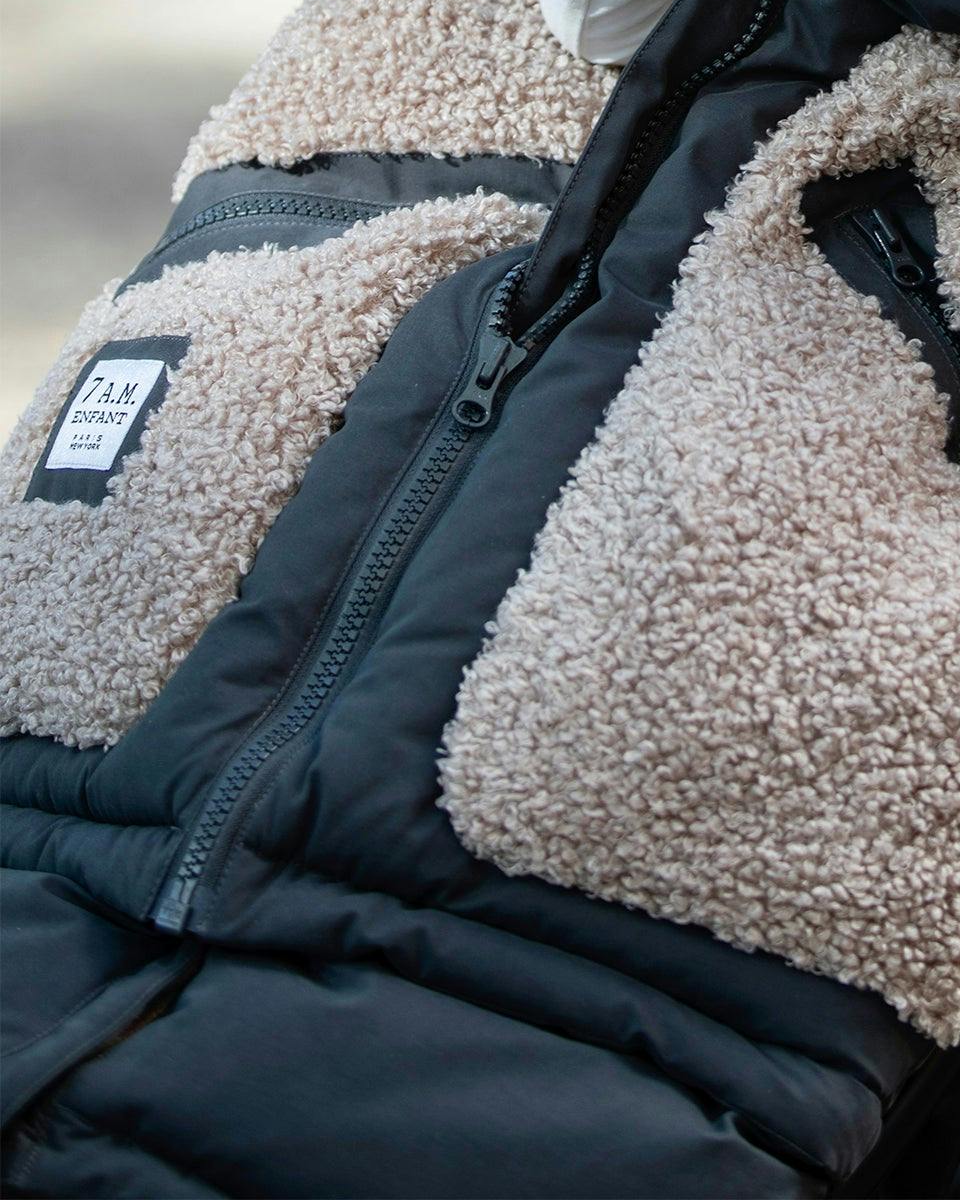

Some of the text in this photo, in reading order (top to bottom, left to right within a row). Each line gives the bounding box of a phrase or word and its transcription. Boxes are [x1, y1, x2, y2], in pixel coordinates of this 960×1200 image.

[82, 377, 138, 405] 7 A.M.
[71, 411, 128, 425] ENFANT
[73, 434, 103, 442] PARIS
